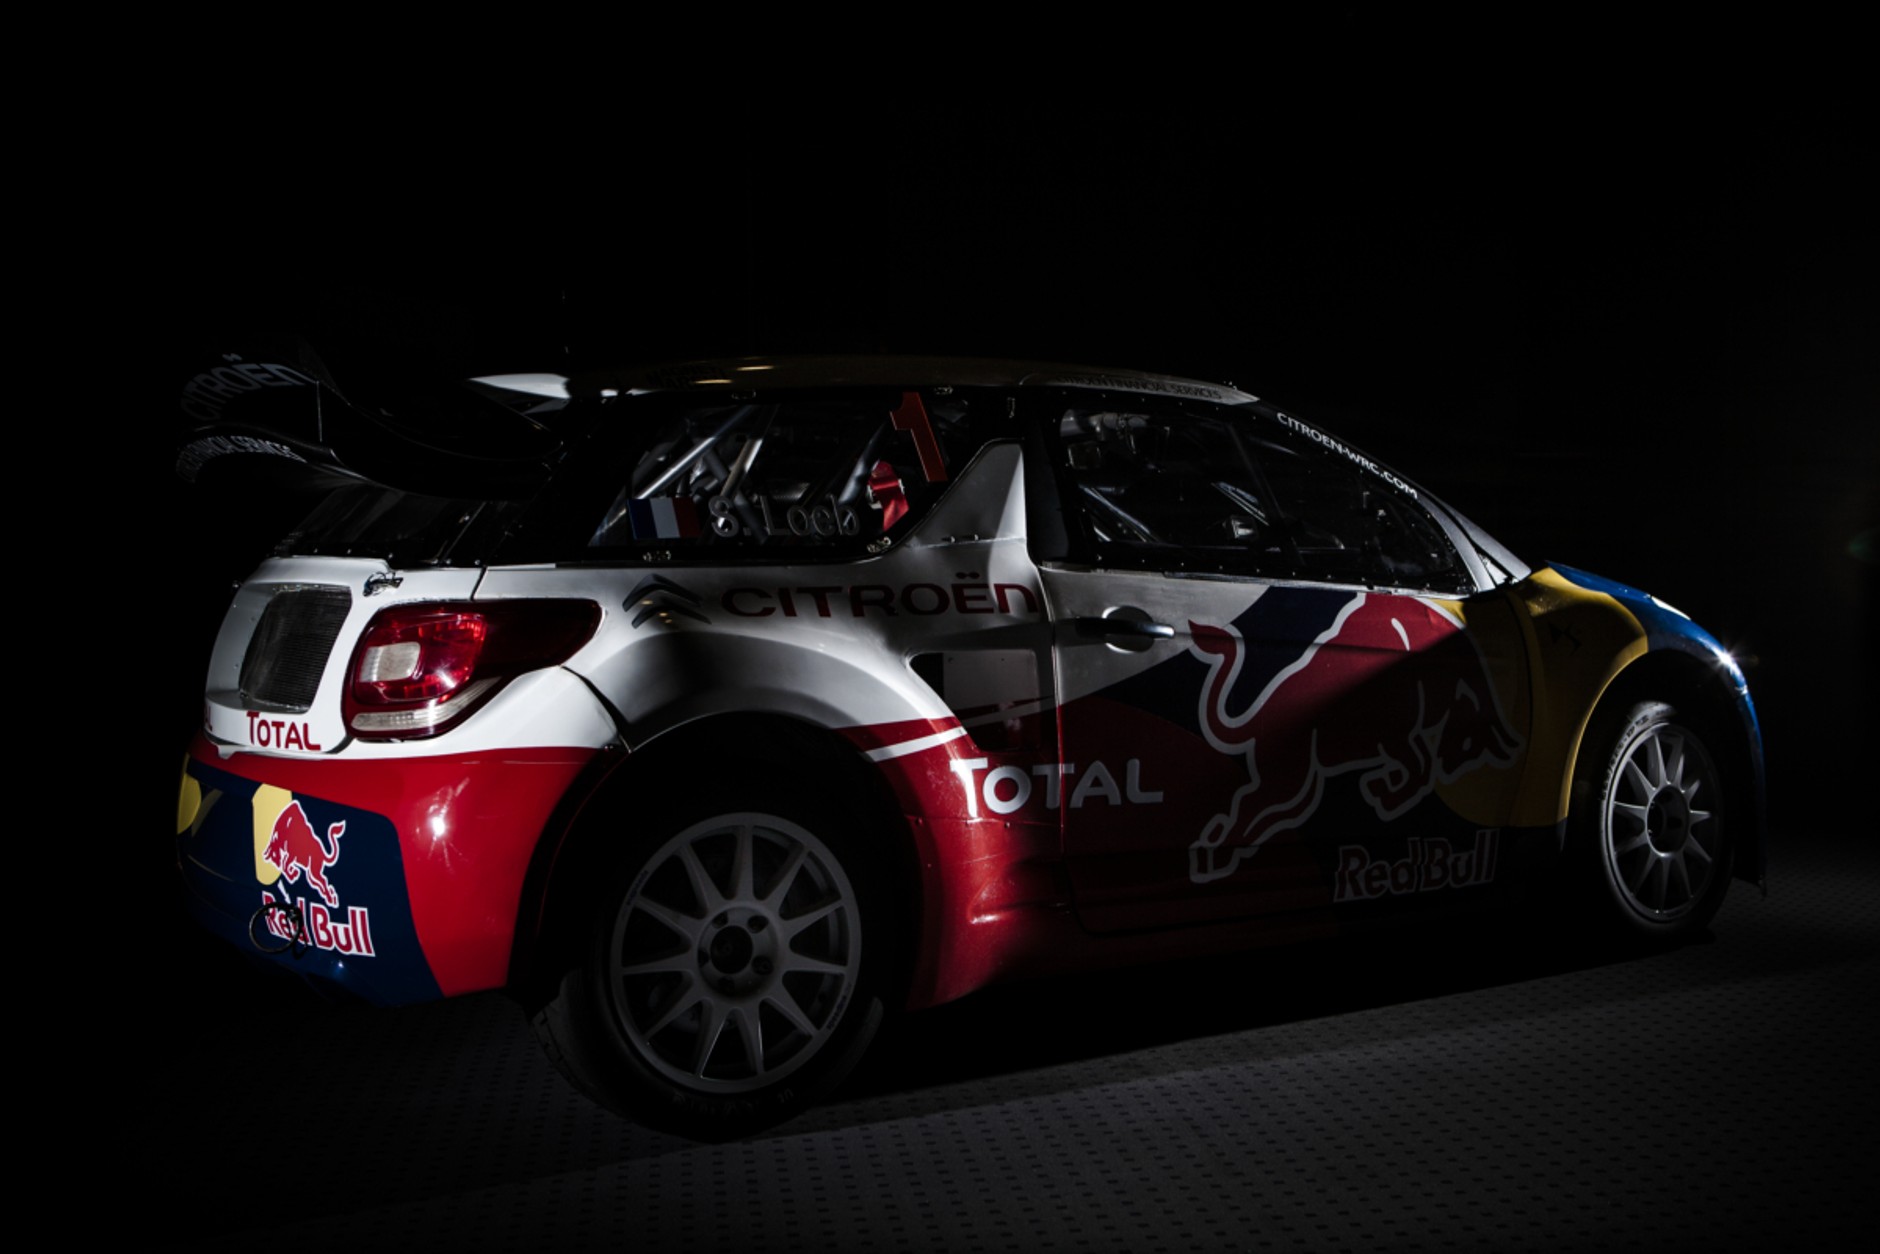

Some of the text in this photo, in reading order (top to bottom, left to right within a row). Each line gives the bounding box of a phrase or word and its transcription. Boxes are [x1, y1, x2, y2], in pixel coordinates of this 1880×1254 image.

[246, 711, 321, 751] TOTAL
[949, 756, 1165, 818] TOTAL
[1332, 827, 1500, 904] Red Bull
[308, 902, 377, 958] Bull
